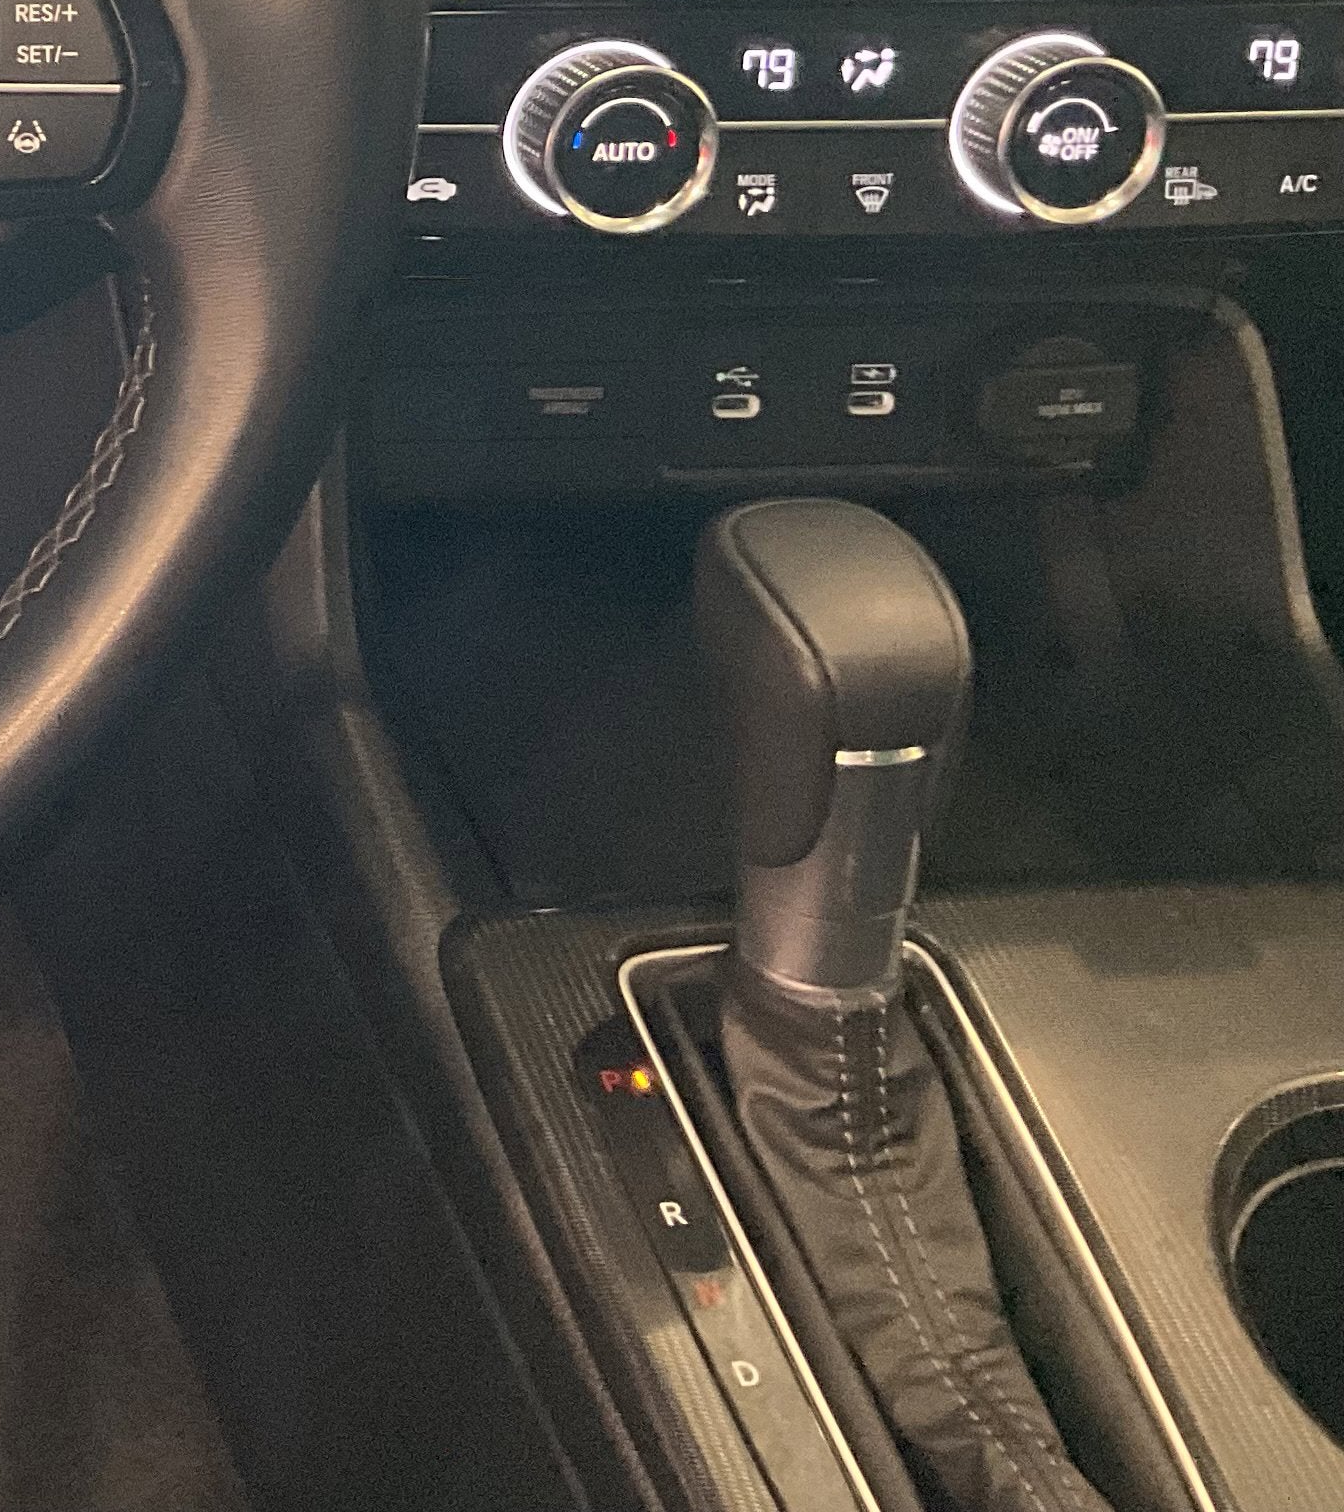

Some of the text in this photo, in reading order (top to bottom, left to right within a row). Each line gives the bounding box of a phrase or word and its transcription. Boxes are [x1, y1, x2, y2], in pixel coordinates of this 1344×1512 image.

[15, 4, 79, 24] RES/+
[742, 49, 796, 90] 79
[1249, 38, 1302, 82] 79
[1062, 127, 1100, 143] ON/
[592, 139, 657, 164] AUTO
[1062, 144, 1099, 160] OFF
[737, 174, 777, 186] MODE
[852, 173, 894, 185] FRONT
[1164, 166, 1198, 179] REAR
[1279, 174, 1318, 193] A/C
[598, 1069, 621, 1092] P
[659, 1202, 688, 1226] R
[732, 1360, 759, 1386] D
